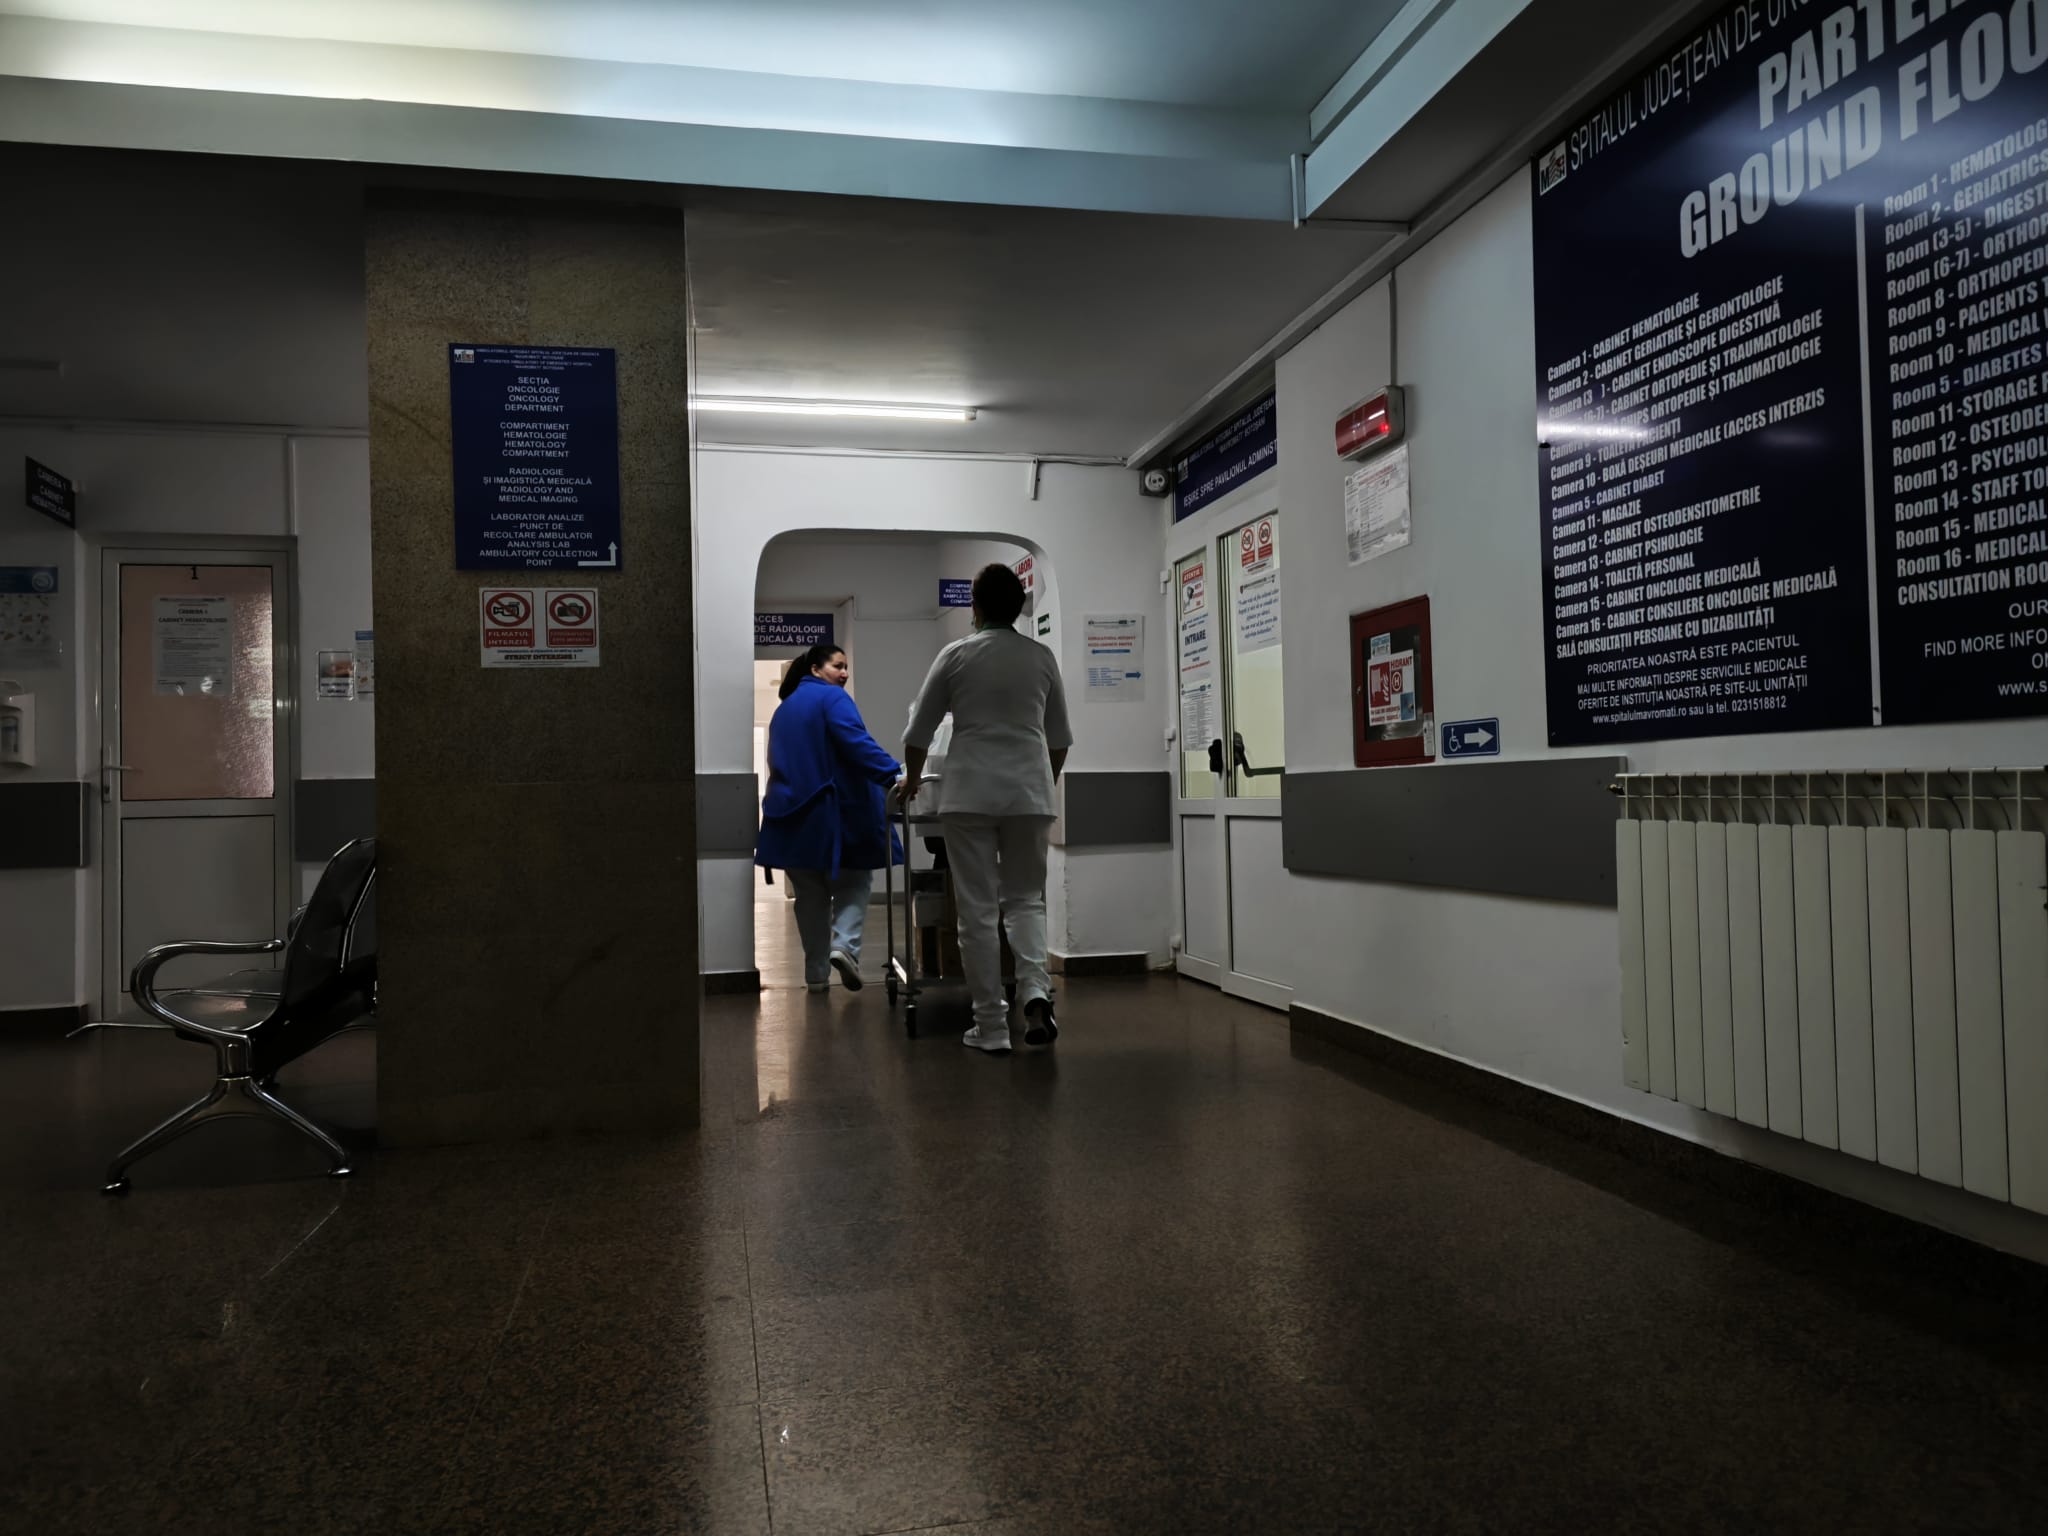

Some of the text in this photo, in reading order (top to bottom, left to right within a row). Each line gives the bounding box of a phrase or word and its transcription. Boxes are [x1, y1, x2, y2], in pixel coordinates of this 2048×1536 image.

[1570, 101, 1638, 171] SPITALUL
[1640, 27, 1731, 124] JUDEȚEAN
[1735, 5, 1762, 56] DE
[1679, 86, 1882, 259] GROUND
[1884, 182, 1928, 216] Room
[1930, 173, 1938, 194] 1
[1885, 211, 1928, 245] Room
[1932, 201, 1941, 222] 2
[1886, 217, 1971, 272] Room (3-5)
[1887, 248, 1969, 300] Room (6-7)
[1888, 288, 1944, 328] Room 8
[1889, 281, 2038, 356] Room 9 PACIENTS
[1548, 292, 1700, 382] Camera CABINET HEMATOLOGIE
[1548, 274, 1784, 401] Camera CABINET GERIATRIE GERONTOLOGIE
[1612, 299, 1781, 393] CABINET ENDOSCOPIE DIGESTIVĂ
[1890, 312, 2040, 383] Room 10 MEDICAL
[1611, 308, 1823, 416] CABINET ORTOPEDIE TRAUMATOLOGIE
[1651, 386, 1706, 421] ORTOPEDIE
[1721, 336, 1822, 393] TRAUMATOLOGIE
[1893, 343, 2042, 410] Room 5 DIABETES
[504, 404, 564, 412] DEPARTMENT
[507, 385, 560, 394] ONCOLOGIE
[508, 394, 560, 403] ONCOLOGY
[500, 422, 570, 431] COMPARTIMENT
[503, 431, 567, 440] HEMATOLOGIE
[1892, 401, 1953, 439] Room 11
[502, 449, 569, 457] COMPARTMENT
[505, 440, 567, 449] HEMATOLOGY
[1551, 477, 1585, 501] Camera
[1670, 425, 1721, 459] MEDICALE
[1723, 407, 1766, 440] (ACCES
[1768, 387, 1825, 425] INTERZIS
[1893, 430, 1957, 467] Room 12
[509, 467, 564, 476] RADIOLOGIE
[1551, 457, 1583, 481] Camera
[1894, 459, 1958, 494] Room 13
[500, 486, 552, 494] RADIOLOGY
[540, 495, 578, 503] IMAGING
[1552, 470, 1664, 520] Camera CABINET DIABET
[1895, 475, 2019, 522] Room 14 STAFF
[483, 531, 593, 540] RECOLTARE AMBULATOR
[491, 513, 545, 521] LABORATOR
[519, 522, 549, 530] PUNCT
[1552, 499, 1641, 540] Camera MAGAZIE
[1553, 485, 1761, 560] Camera 12 CABINET OSTEODENSITOMETRIE
[1896, 499, 2047, 550] Room 15 MEDICAL
[507, 540, 551, 548] ANALYSIS
[542, 550, 598, 558] COLLECTION
[1554, 526, 1704, 579] Camera 13 CABINET PSIHOLOGIE
[1897, 529, 2048, 578] Room 16 MEDICAL
[1554, 577, 1587, 599] Camera
[1644, 551, 1695, 578] PERSONAL
[1555, 556, 1761, 619] Camera CABINET ONCOLOGIE MEDICALĂ
[1898, 567, 2010, 606] CONSULTATION
[1556, 564, 1838, 640] Camera CABINET CONSILIERE ONCOLOGIE MEDICALĂ
[769, 625, 827, 634] RADIOLOGIE
[1184, 629, 1206, 646] INTRARE
[1633, 622, 1683, 646] PERSOANE
[1685, 620, 1699, 638] CU
[1924, 633, 2005, 658] FIND MORE
[1391, 656, 1412, 670] HIDRANT
[1587, 656, 1646, 675] PRIORITATEA
[1700, 643, 1728, 660] ESTE
[1731, 633, 1800, 656] PACIENTUL
[1577, 655, 1808, 696] MAI MULTE DESPRE SERVICIILE MEDICALE
[1577, 695, 1608, 711] OFERITE
[1610, 694, 1620, 707] DE
[1710, 684, 1722, 698] PE
[1724, 678, 1762, 696] SITE-UL
[1731, 696, 1787, 713] 0231518812
